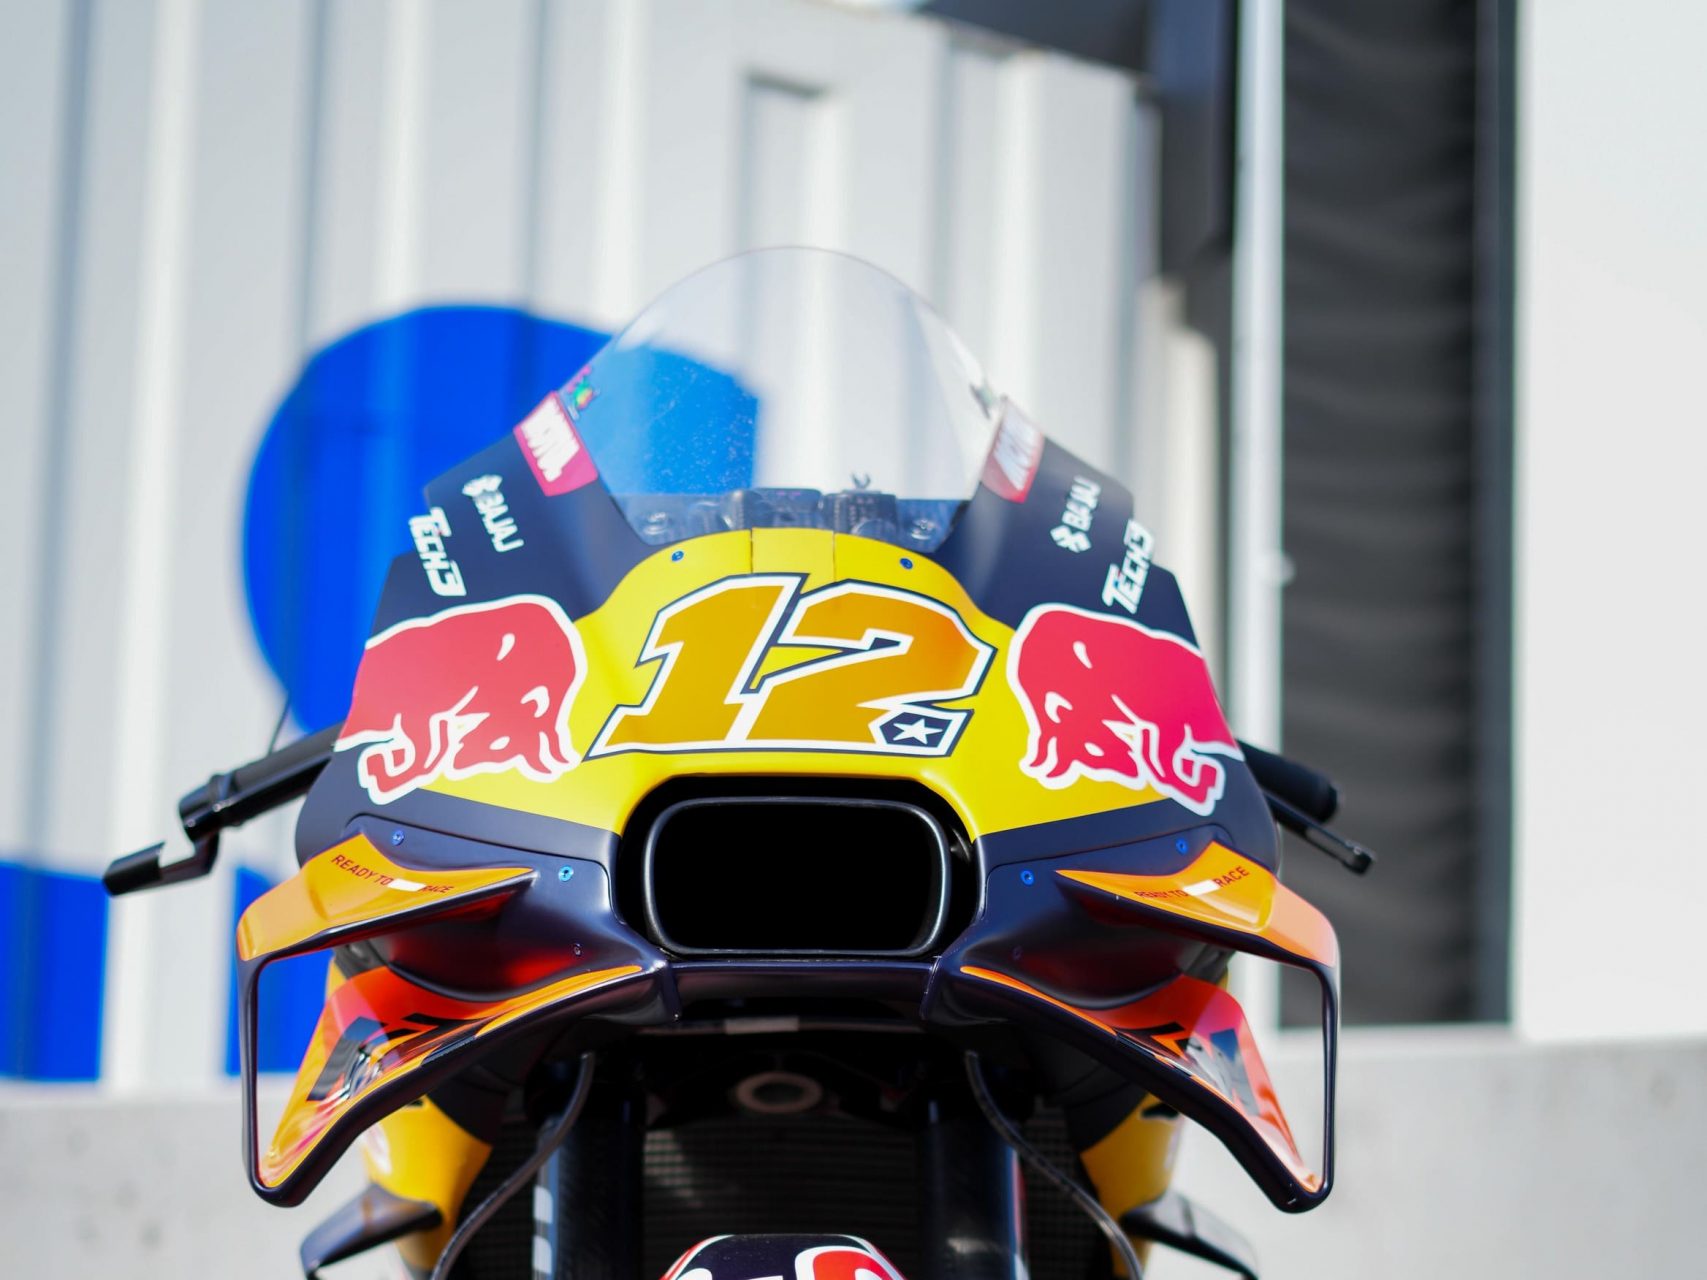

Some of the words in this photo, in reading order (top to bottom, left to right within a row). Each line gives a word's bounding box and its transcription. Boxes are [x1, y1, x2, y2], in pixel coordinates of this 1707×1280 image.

[582, 573, 998, 761] 12
[331, 854, 378, 879] READY
[374, 875, 394, 886] TO
[1212, 866, 1250, 887] RACE
